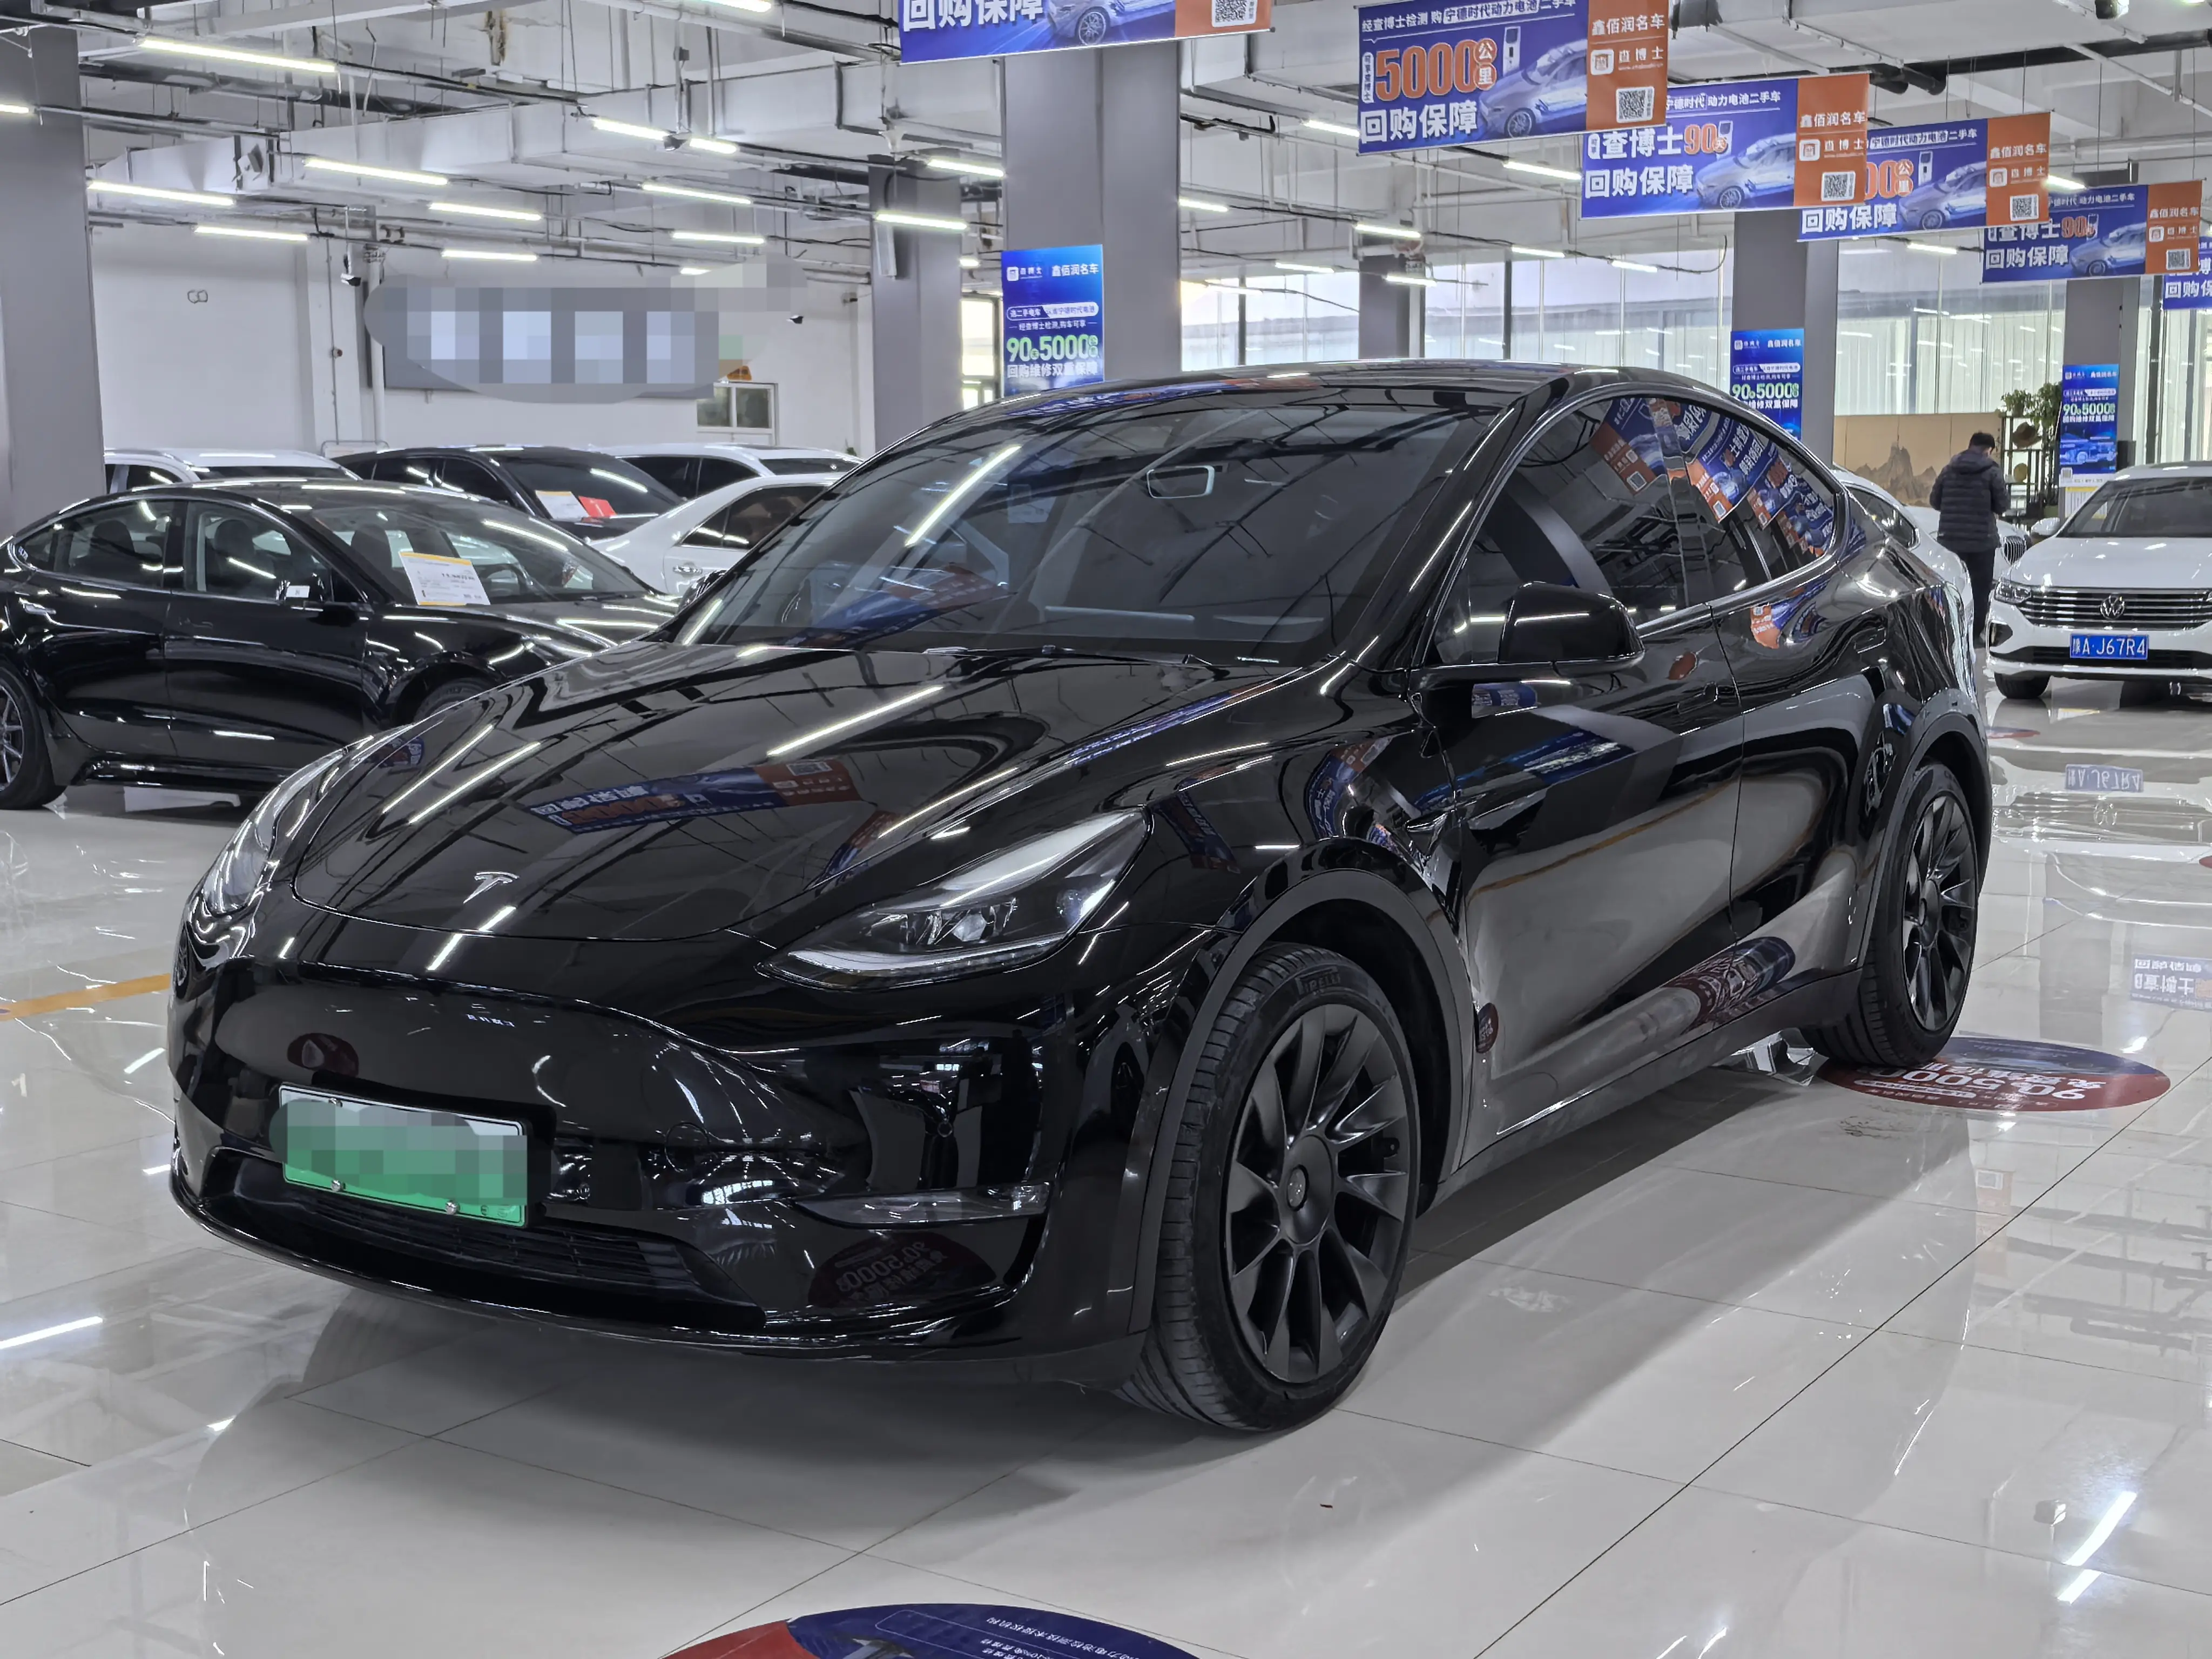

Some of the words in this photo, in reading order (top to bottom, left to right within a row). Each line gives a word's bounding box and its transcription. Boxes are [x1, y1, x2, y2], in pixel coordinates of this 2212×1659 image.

[1360, 99, 1478, 144] 回购保障
[1584, 164, 1694, 199] 回购保障
[1802, 203, 1898, 234] 回购保障
[1986, 244, 2069, 270] 回购保障
